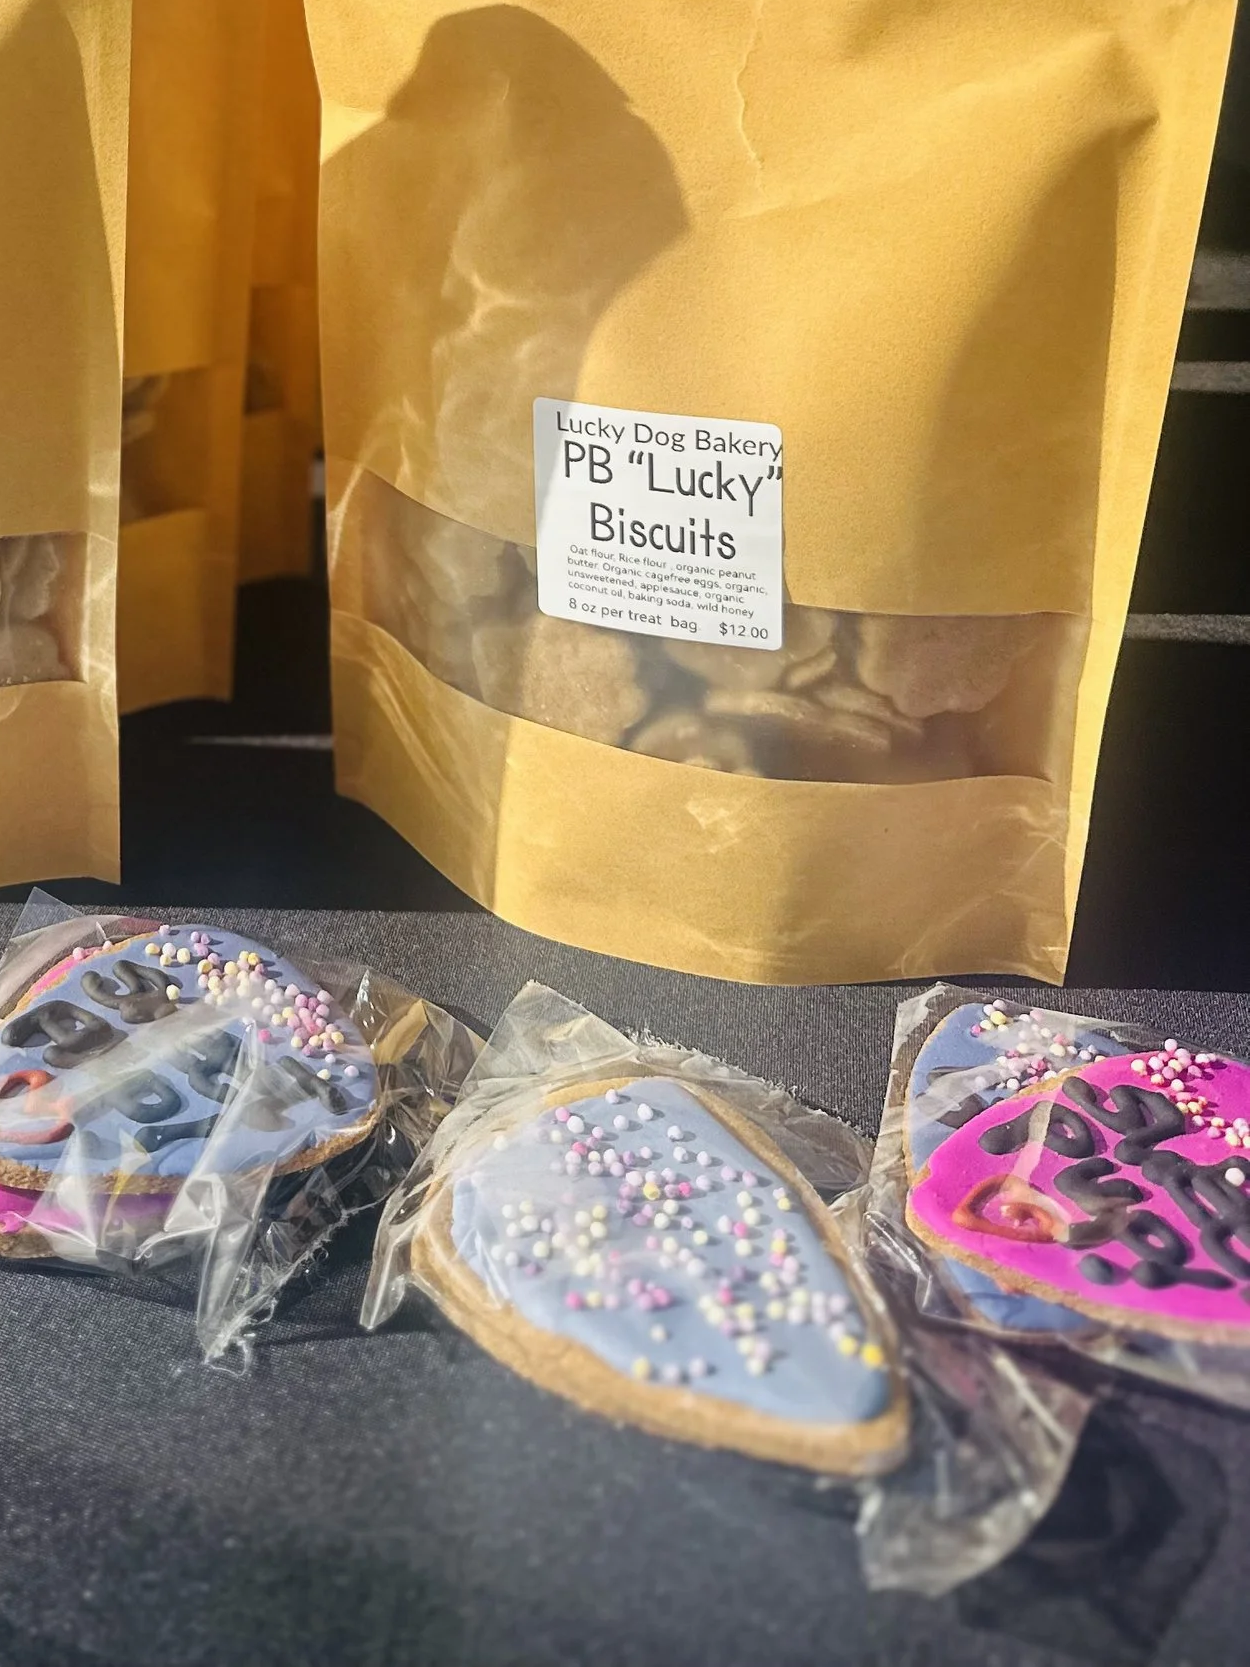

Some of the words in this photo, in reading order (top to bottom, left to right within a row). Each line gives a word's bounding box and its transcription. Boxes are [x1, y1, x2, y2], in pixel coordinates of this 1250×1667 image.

[557, 411, 625, 444] Lucky
[634, 423, 685, 451] Dog
[696, 430, 783, 461] Bakery
[564, 440, 613, 484] PB
[590, 502, 737, 559] Biscuits
[570, 545, 588, 556] Oat
[619, 553, 641, 565] Rice
[643, 557, 666, 569] flour
[676, 564, 715, 575] organic
[719, 567, 756, 580] peanut
[603, 563, 642, 577] Organic
[568, 581, 608, 595] coconut
[628, 590, 664, 606] baking
[696, 602, 720, 613] wild
[721, 605, 754, 619] honey
[705, 591, 745, 604] organic
[569, 598, 577, 609] 8
[582, 603, 596, 613] oz
[601, 607, 624, 618] per
[628, 610, 662, 625] treat
[719, 621, 768, 639] $12.00
